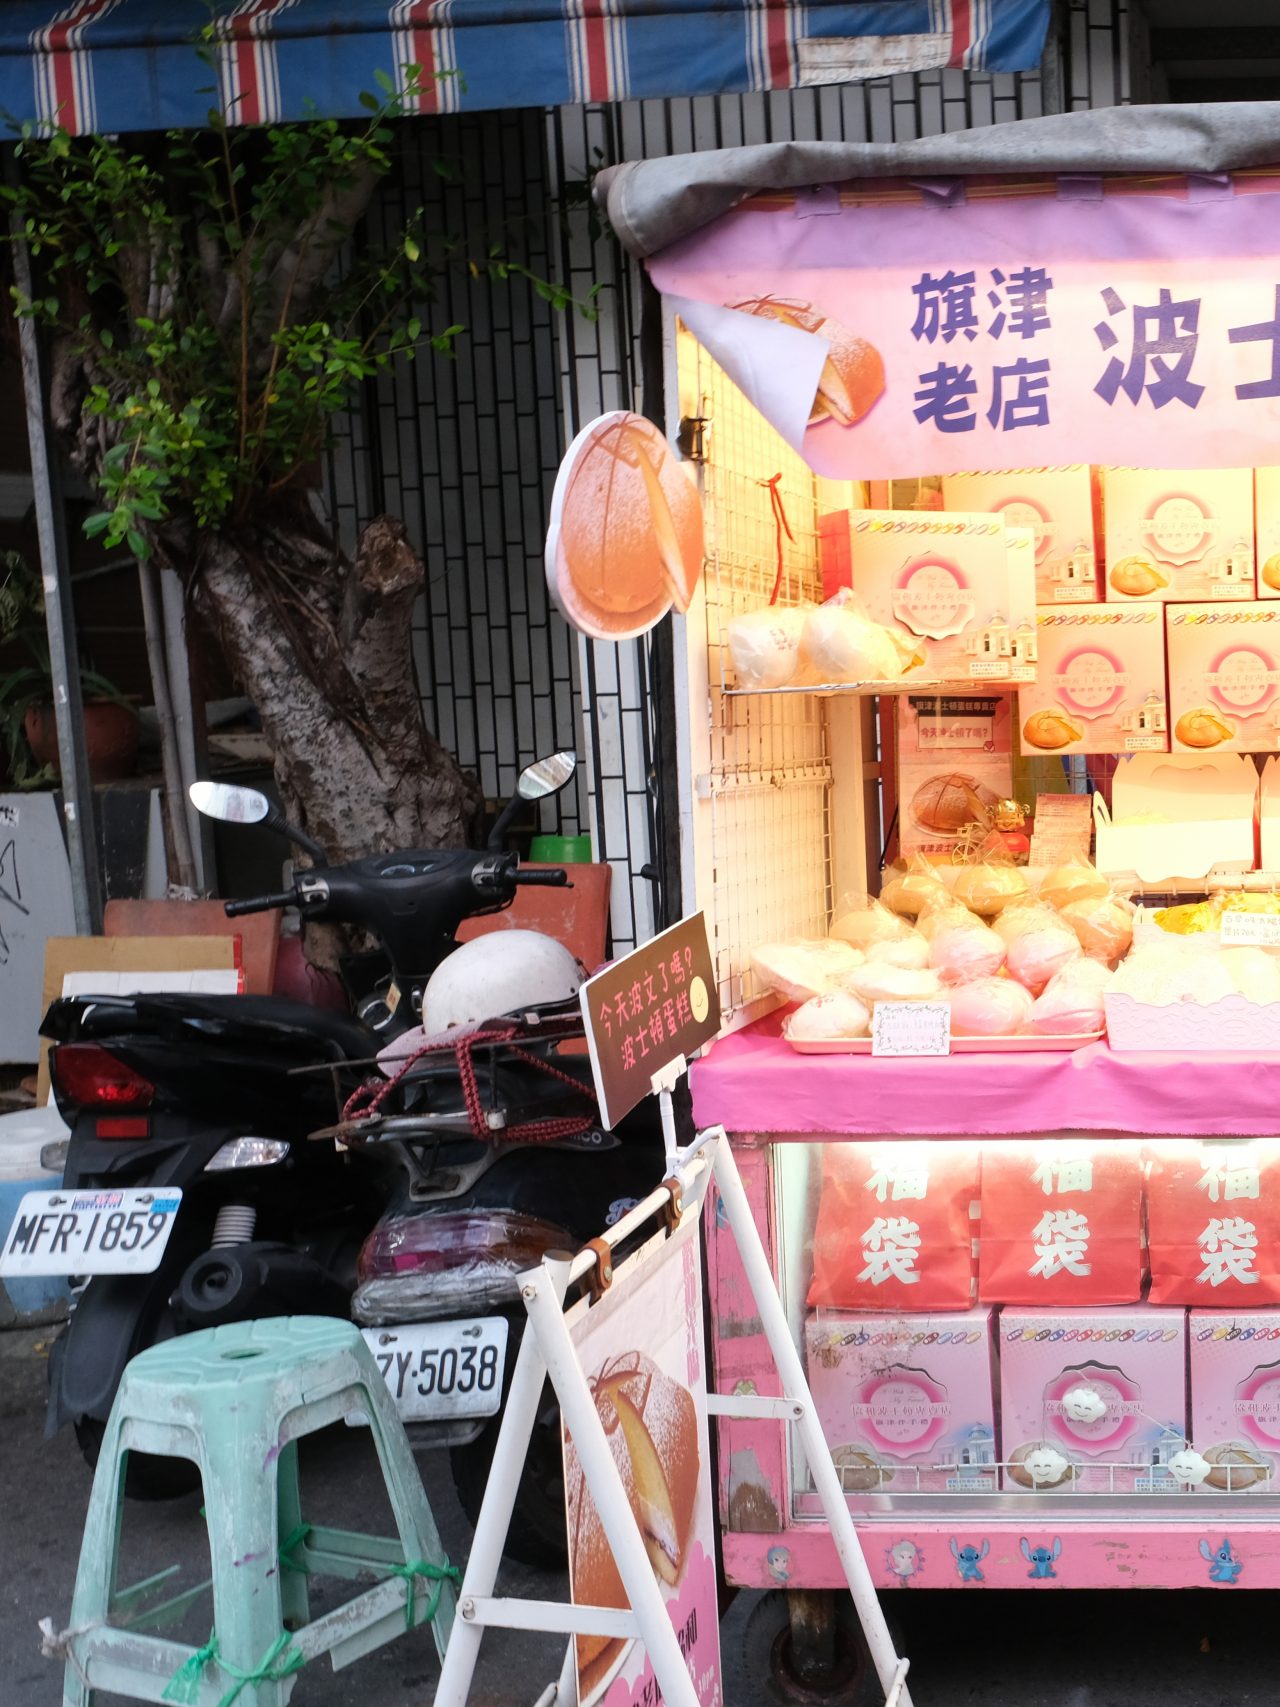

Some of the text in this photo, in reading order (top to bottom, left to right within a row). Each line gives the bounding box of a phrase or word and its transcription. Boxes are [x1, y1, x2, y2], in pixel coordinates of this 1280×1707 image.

[910, 265, 1053, 345] 旗津
[911, 357, 1052, 434] 老店
[621, 990, 693, 1071] 波士頓蛋糕
[9, 1212, 168, 1255] MFR-1859
[376, 1345, 498, 1398] ZY-5038
